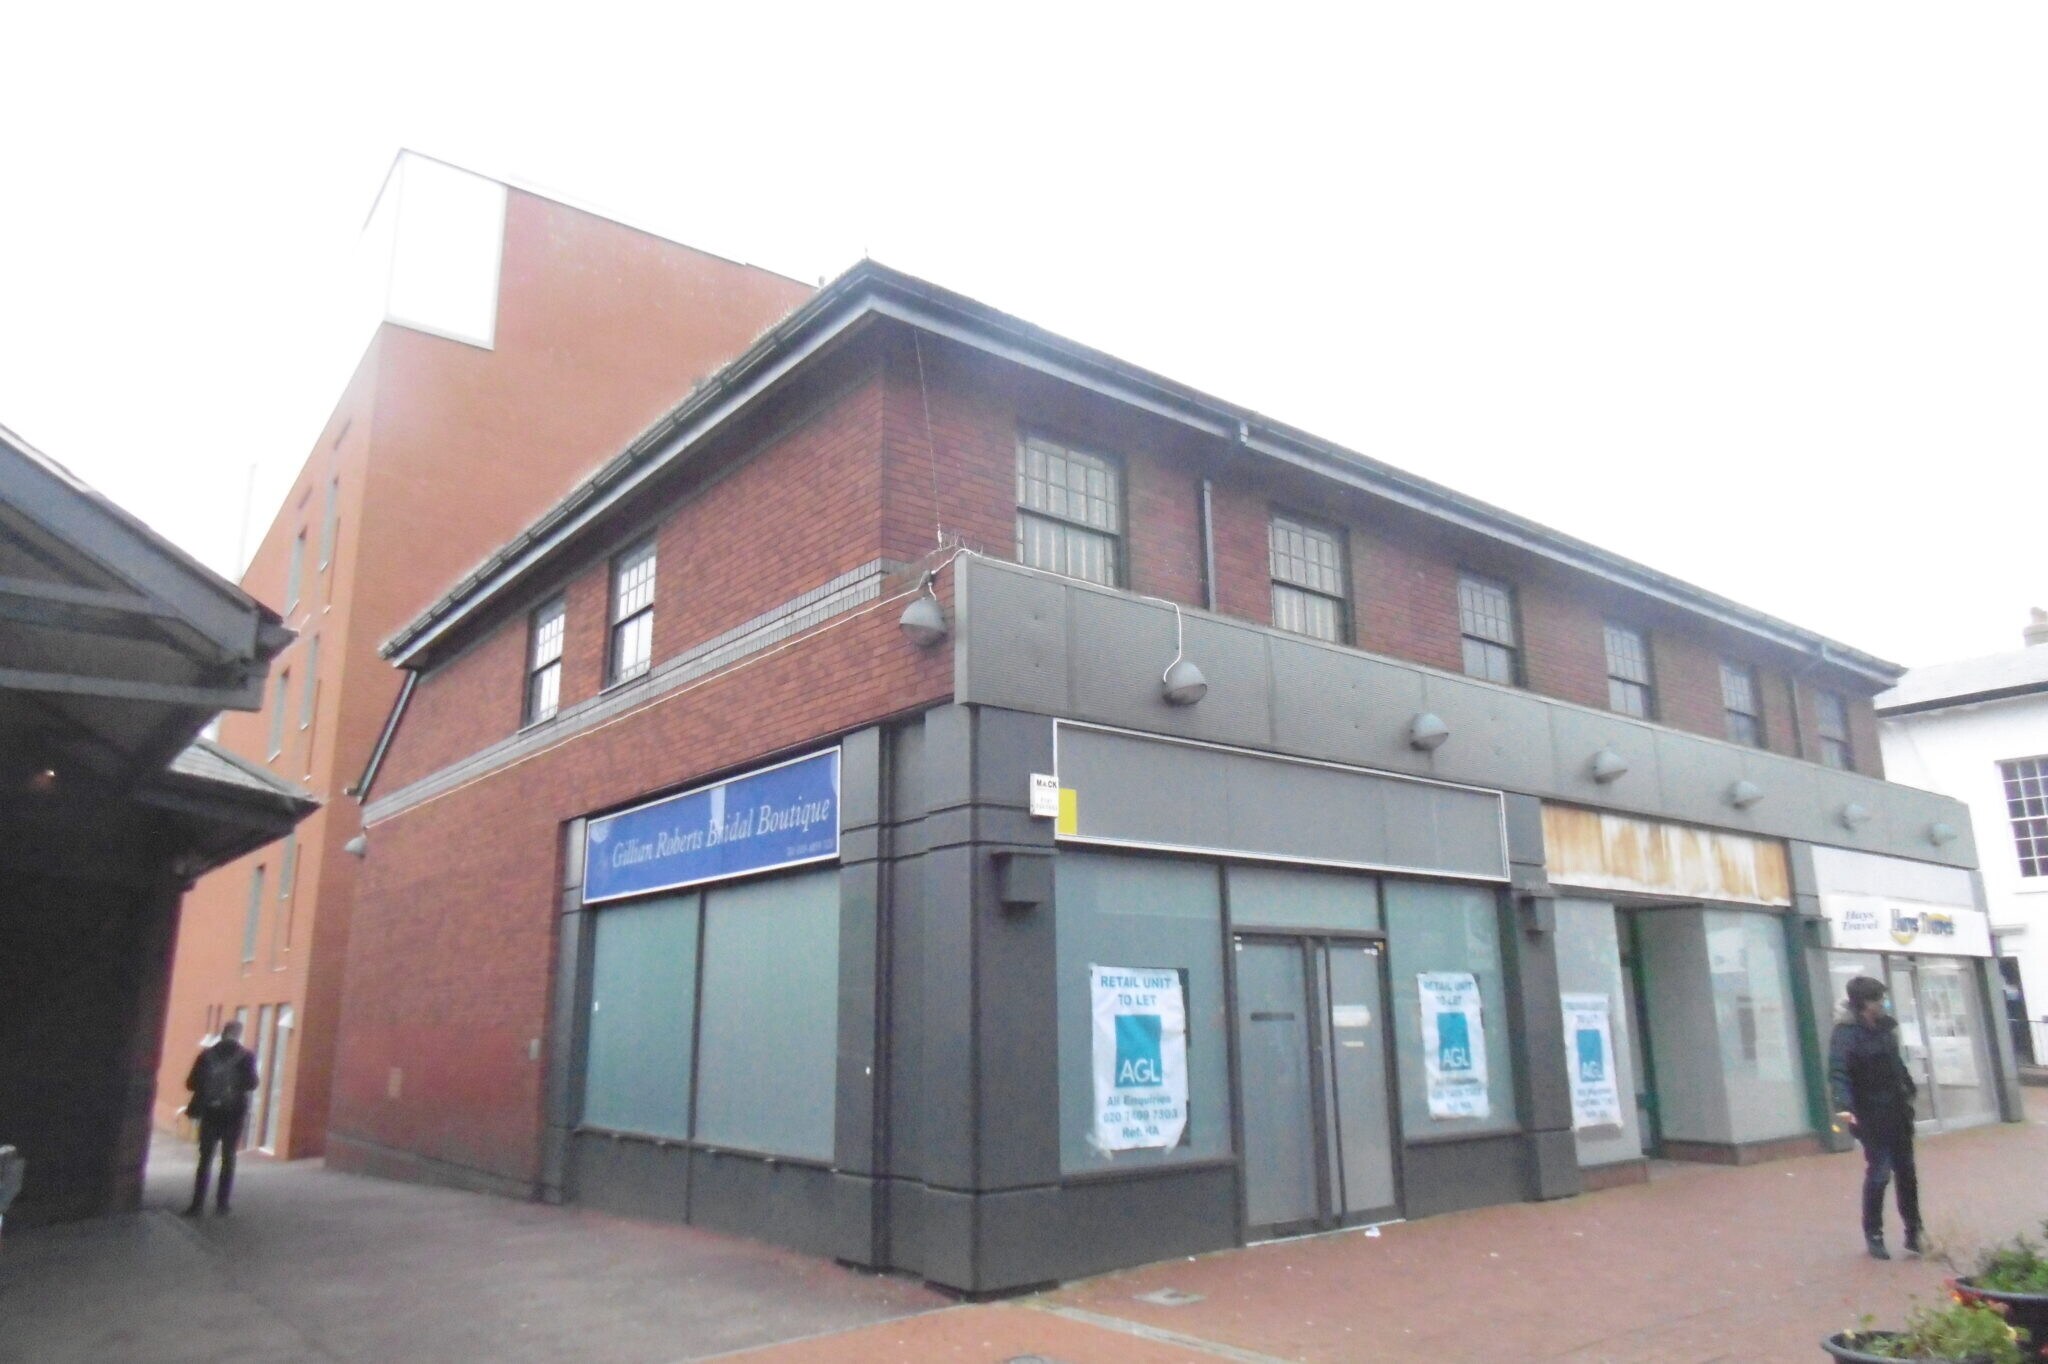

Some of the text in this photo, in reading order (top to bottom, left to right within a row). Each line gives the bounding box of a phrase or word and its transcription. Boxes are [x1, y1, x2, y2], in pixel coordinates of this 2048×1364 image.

[656, 827, 703, 858] Roberts
[706, 808, 754, 847] Bridal
[756, 795, 830, 835] Boutique
[1101, 976, 1171, 988] RETAIL UNIT
[1118, 995, 1156, 1006] TO LET
[1119, 1059, 1161, 1083] AGL
